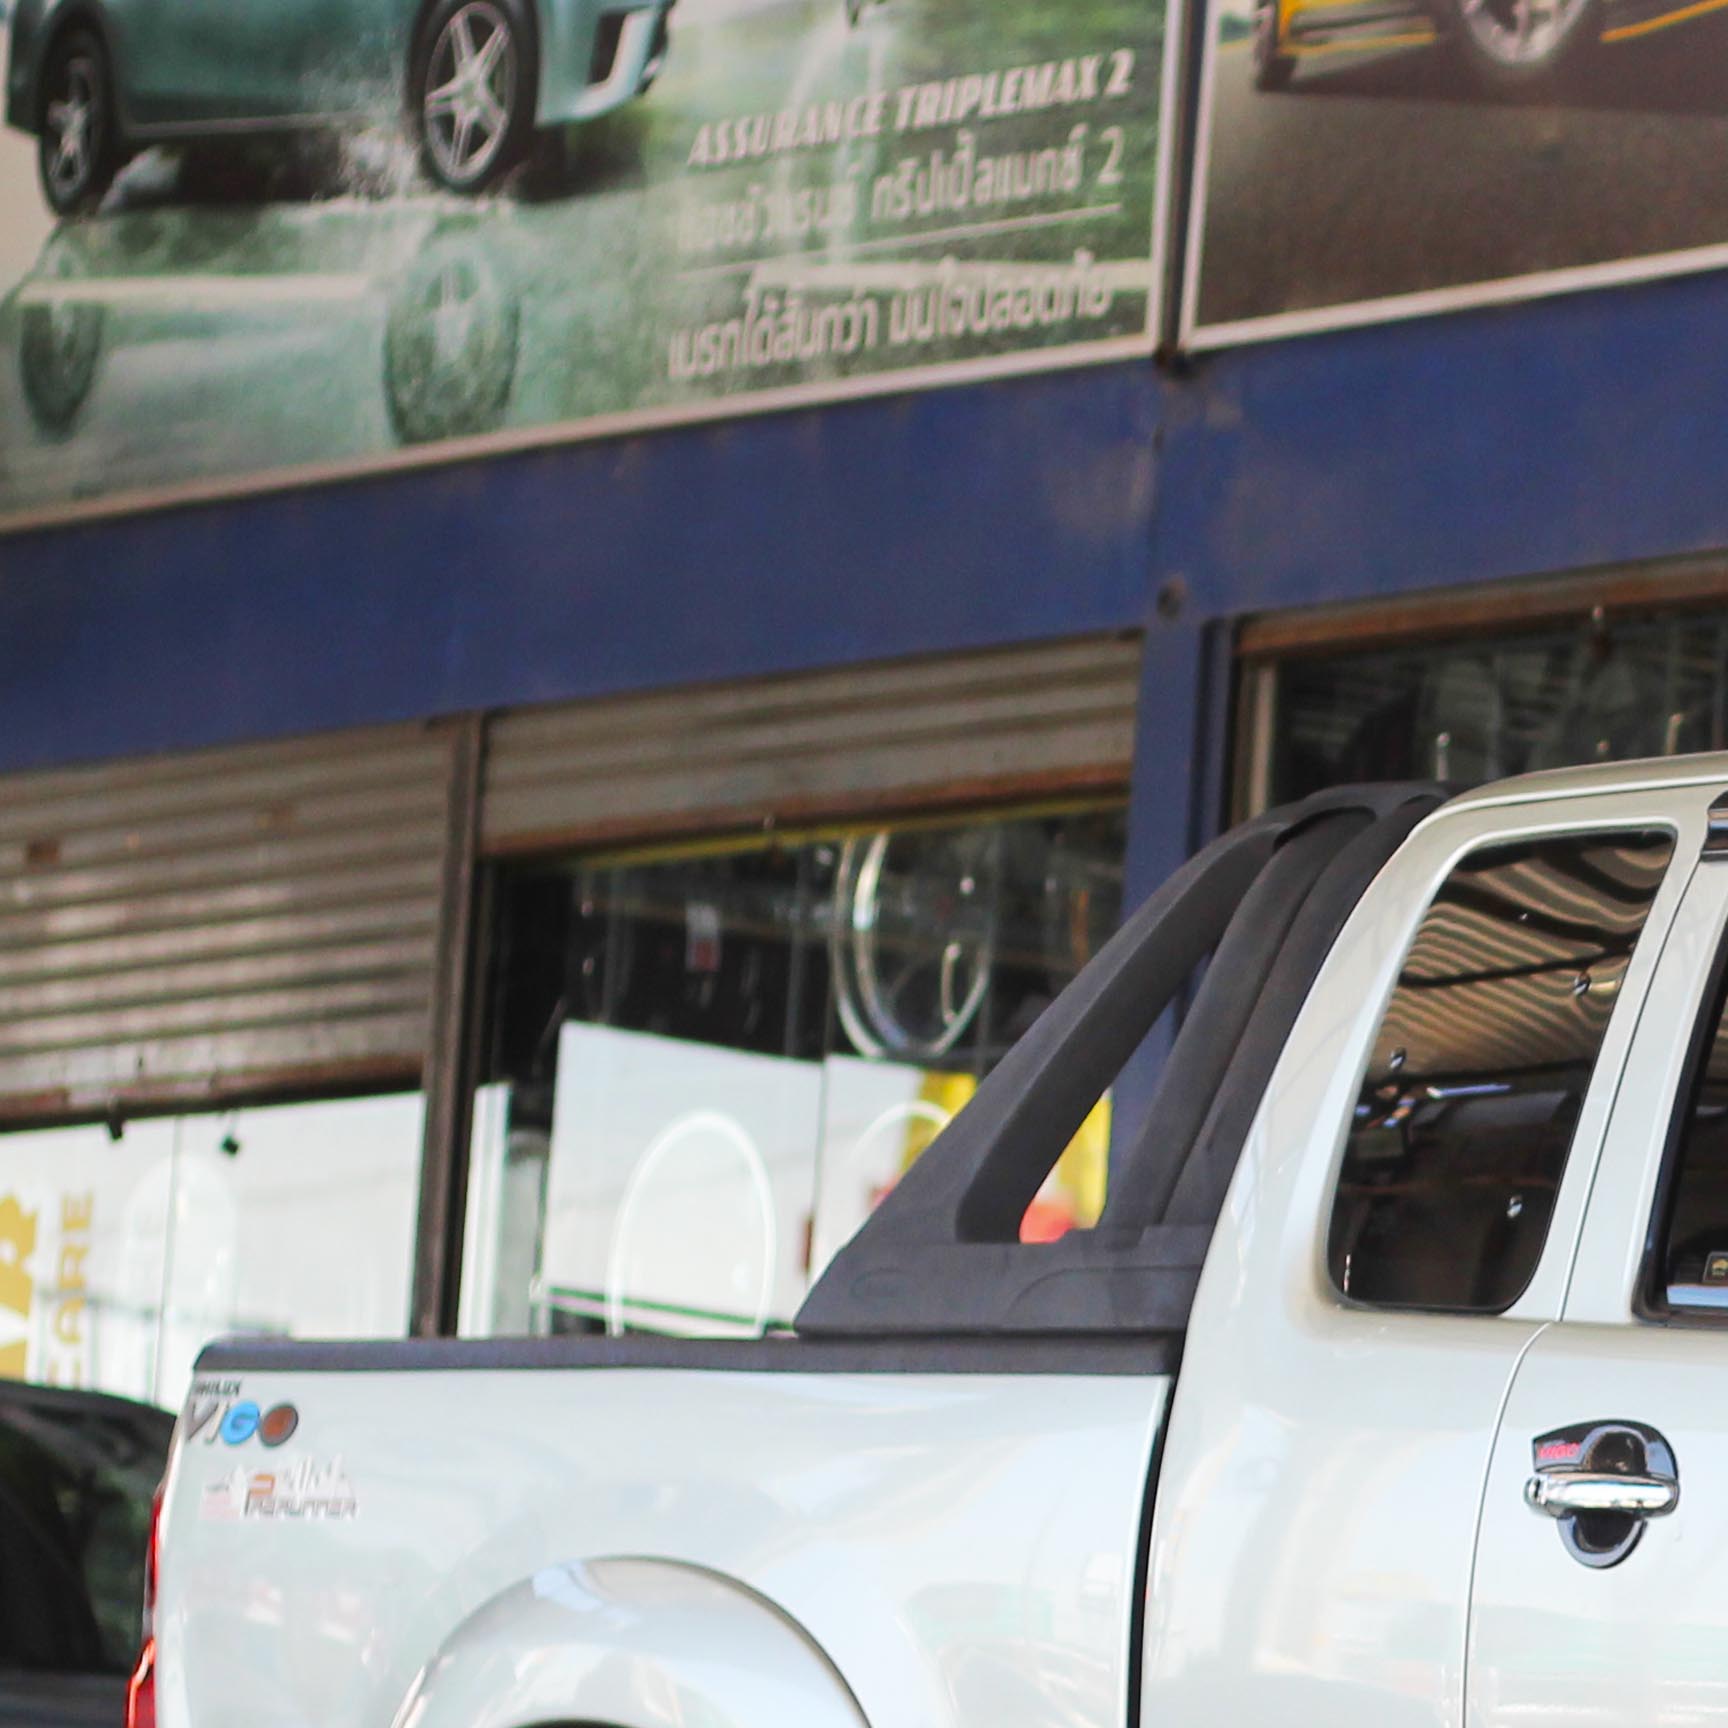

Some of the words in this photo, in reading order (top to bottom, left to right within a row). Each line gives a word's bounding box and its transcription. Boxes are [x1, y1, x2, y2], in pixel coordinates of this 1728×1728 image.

[687, 93, 889, 165] ASSURANCE
[895, 54, 1104, 131] TRIPLEMAX
[1104, 47, 1136, 96] 2
[1097, 125, 1124, 185] 2
